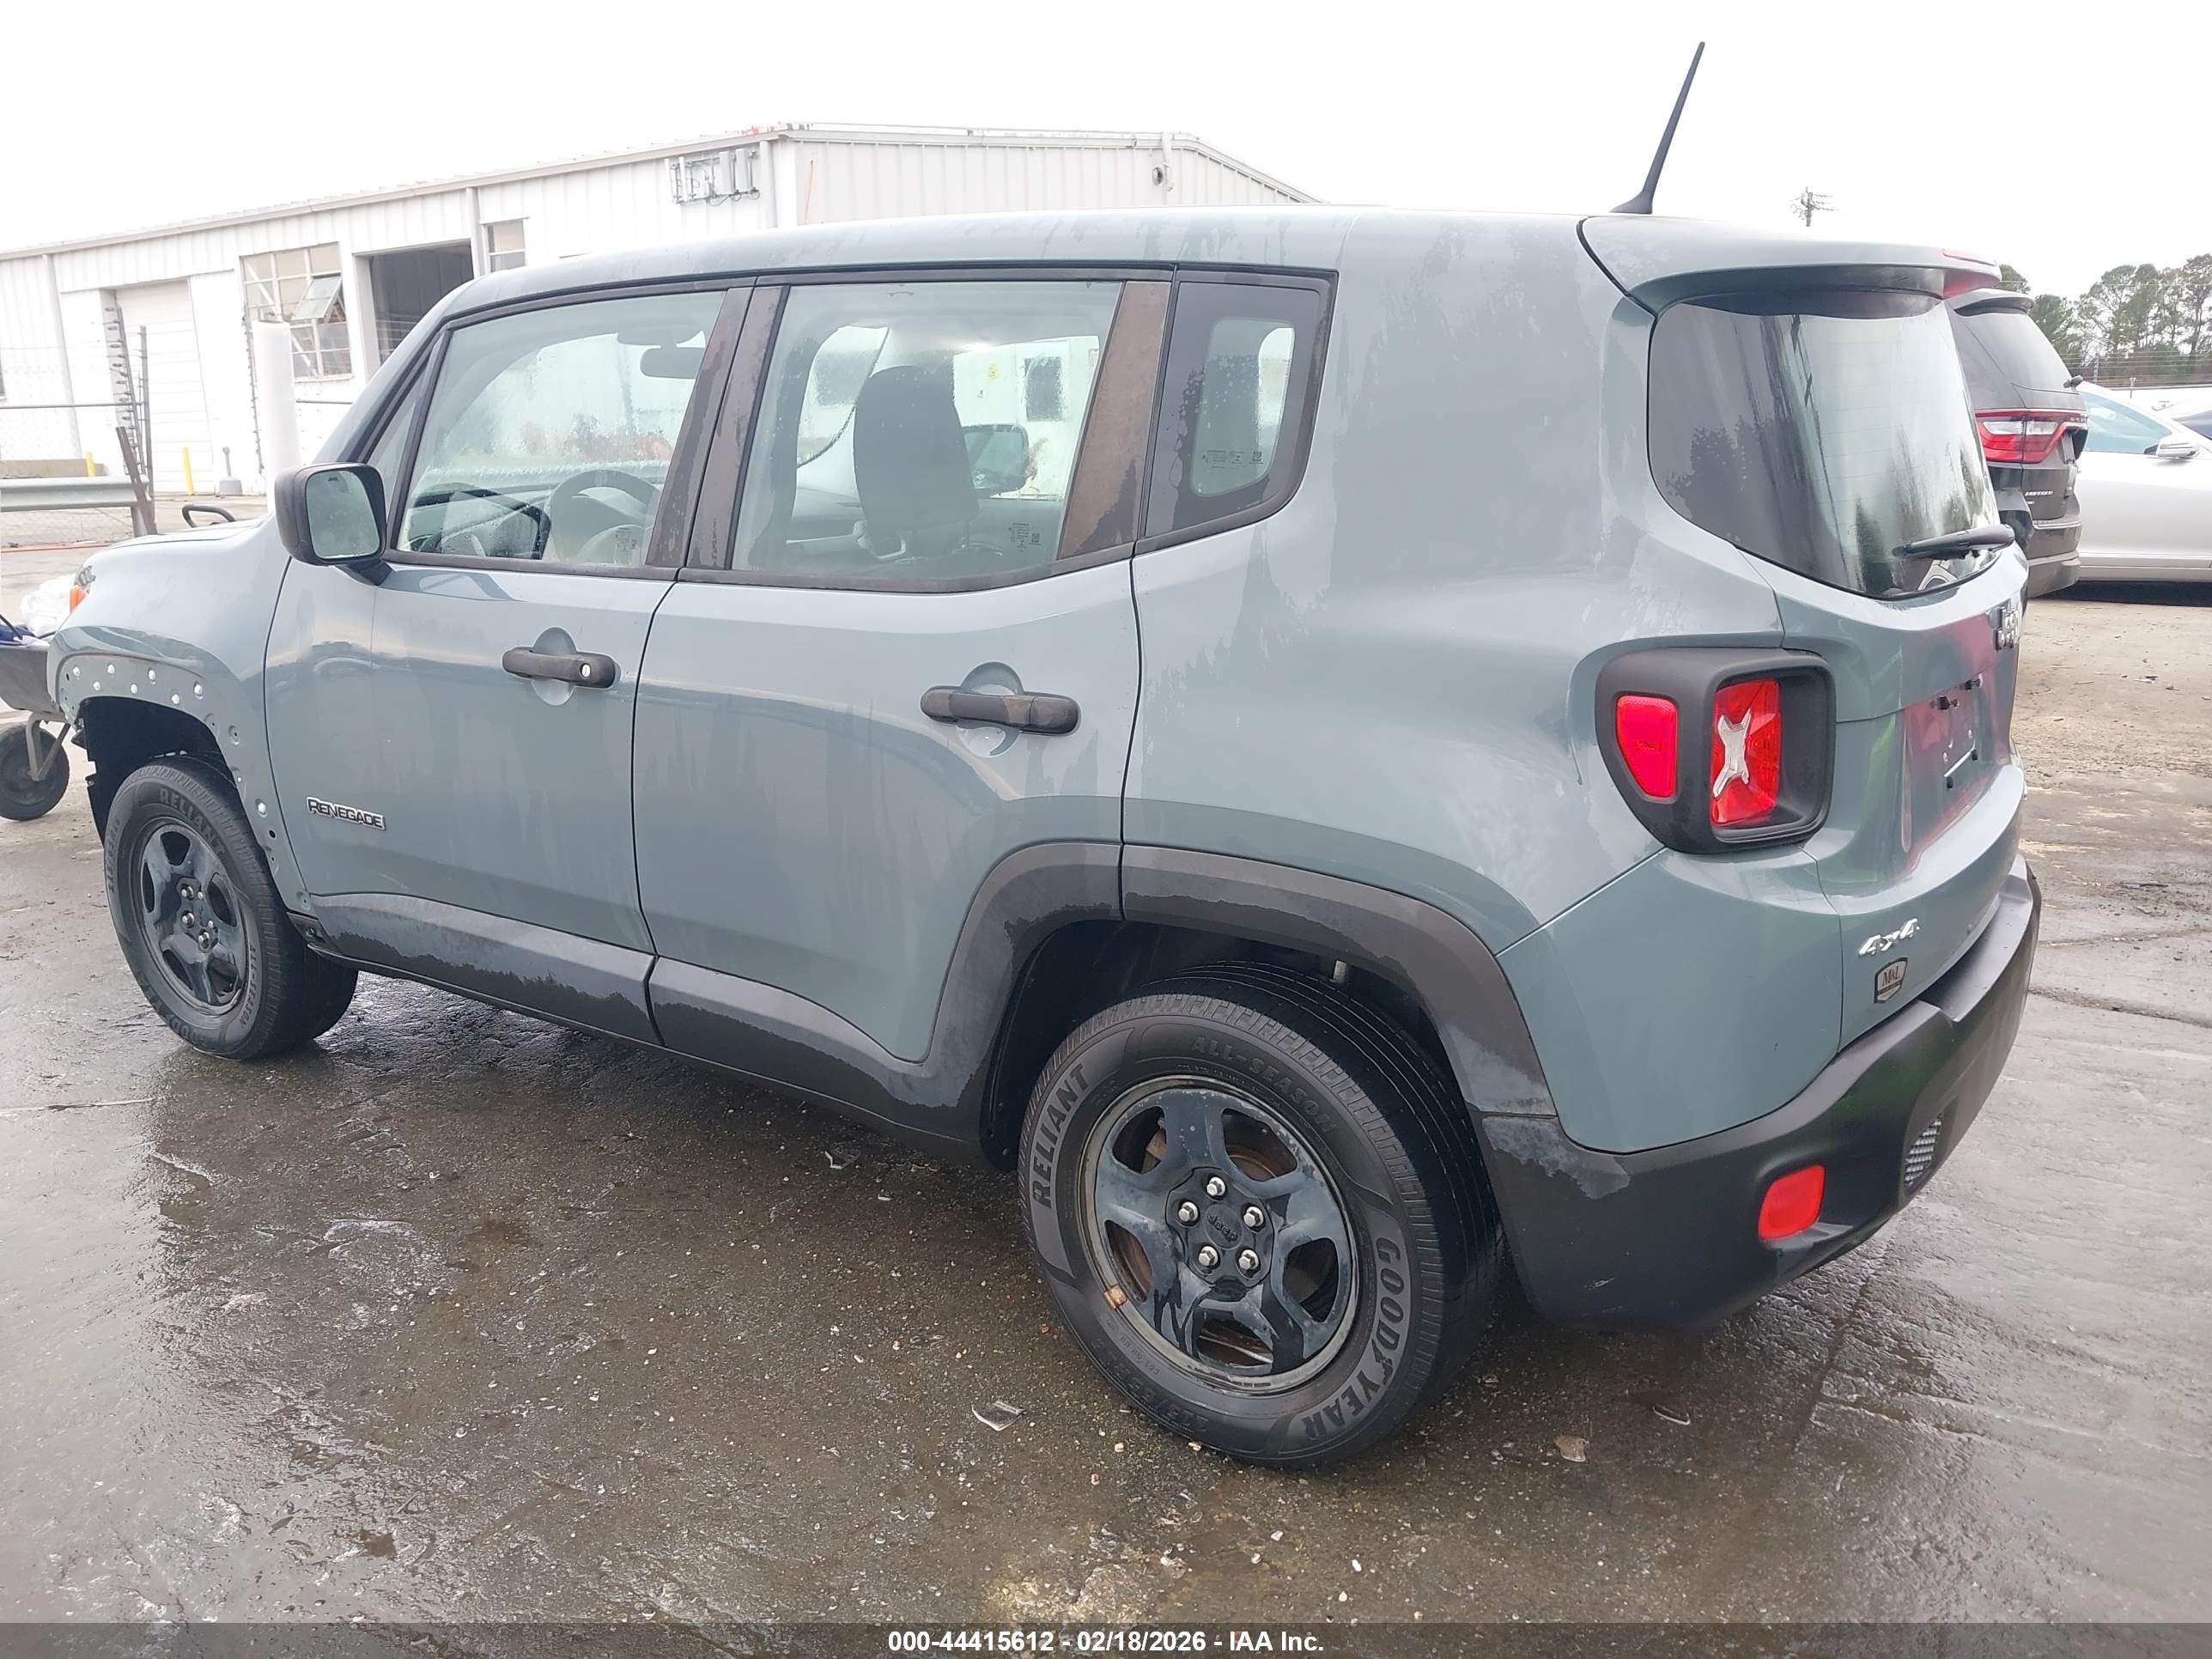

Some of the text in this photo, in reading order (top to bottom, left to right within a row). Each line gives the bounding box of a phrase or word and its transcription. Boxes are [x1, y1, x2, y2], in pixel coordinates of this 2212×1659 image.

[158, 787, 227, 859] RELIANT
[306, 796, 386, 830] RENEGADE
[1193, 1036, 1338, 1133] ALL-SEASON
[1031, 1062, 1089, 1210] RELIANT
[1206, 1212, 1238, 1242] Jeep
[1301, 1236, 1406, 1441] GOODYEAR
